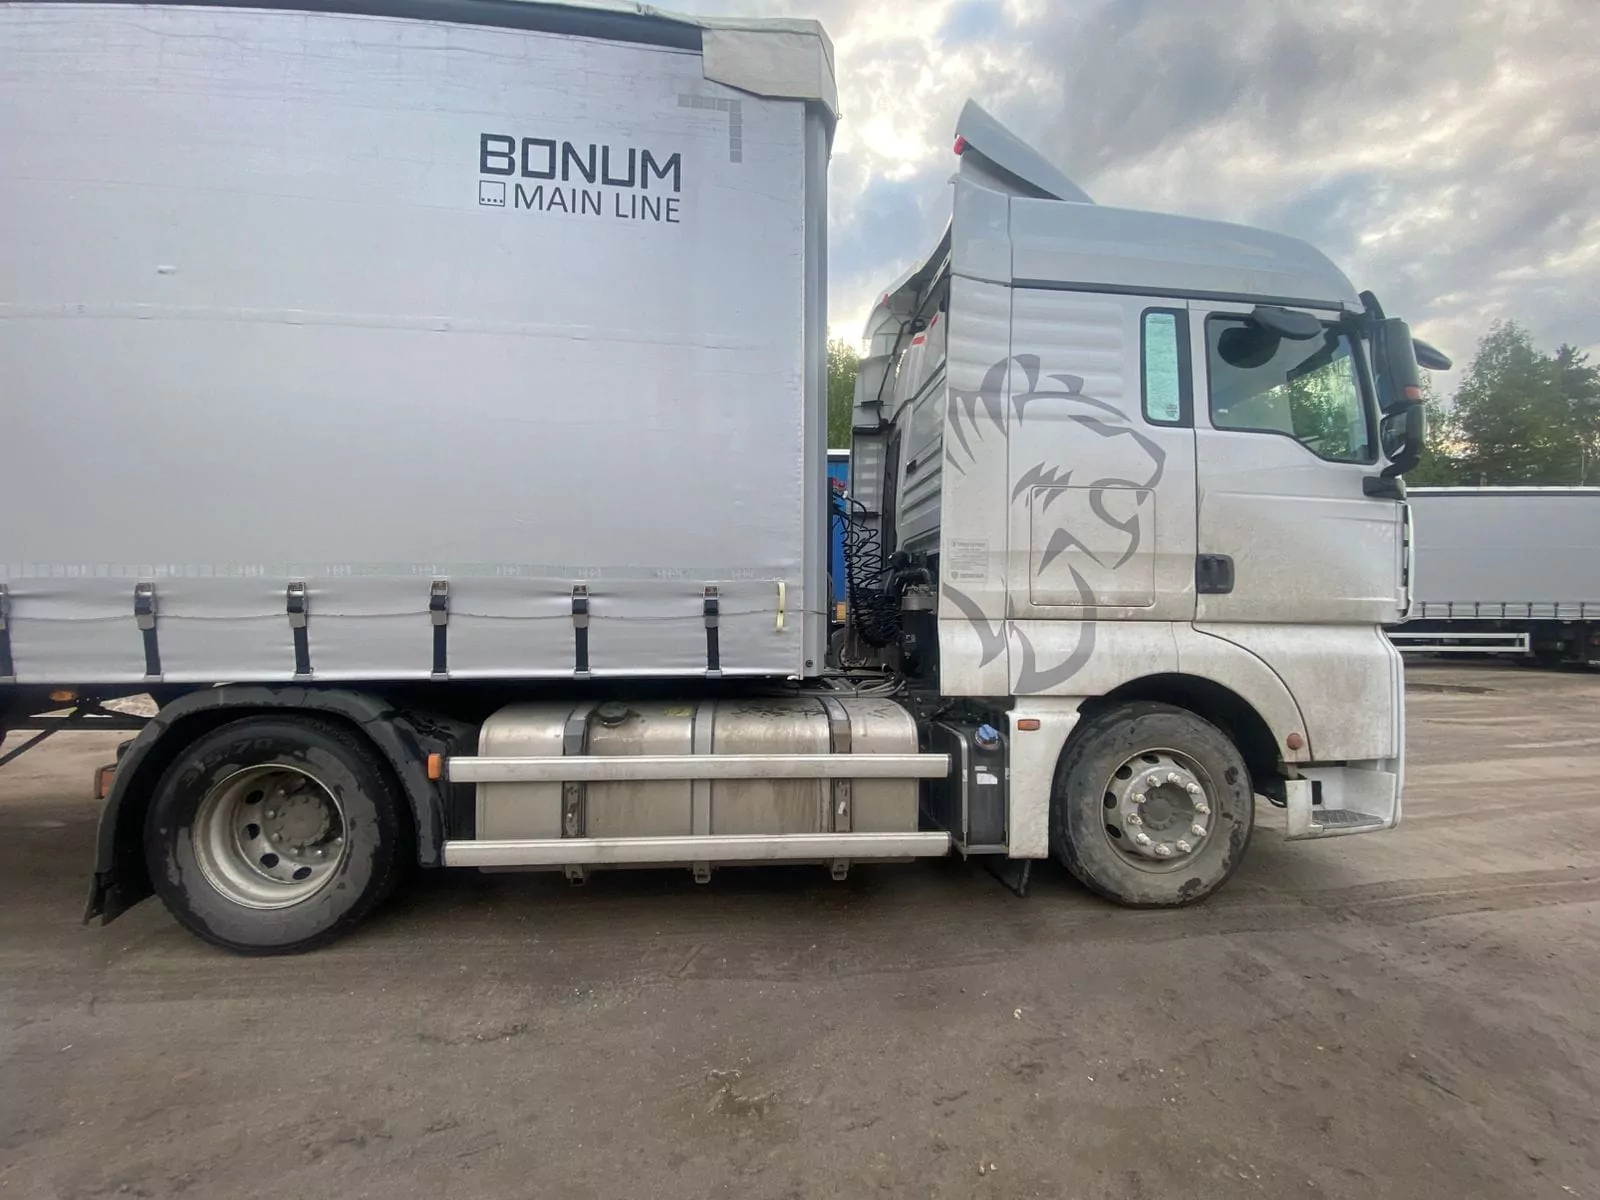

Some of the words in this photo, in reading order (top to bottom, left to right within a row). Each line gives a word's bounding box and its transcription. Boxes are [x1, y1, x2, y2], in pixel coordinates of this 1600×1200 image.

[480, 133, 681, 193] BONUM
[514, 183, 601, 216] MAIN
[615, 192, 681, 223] LINE
